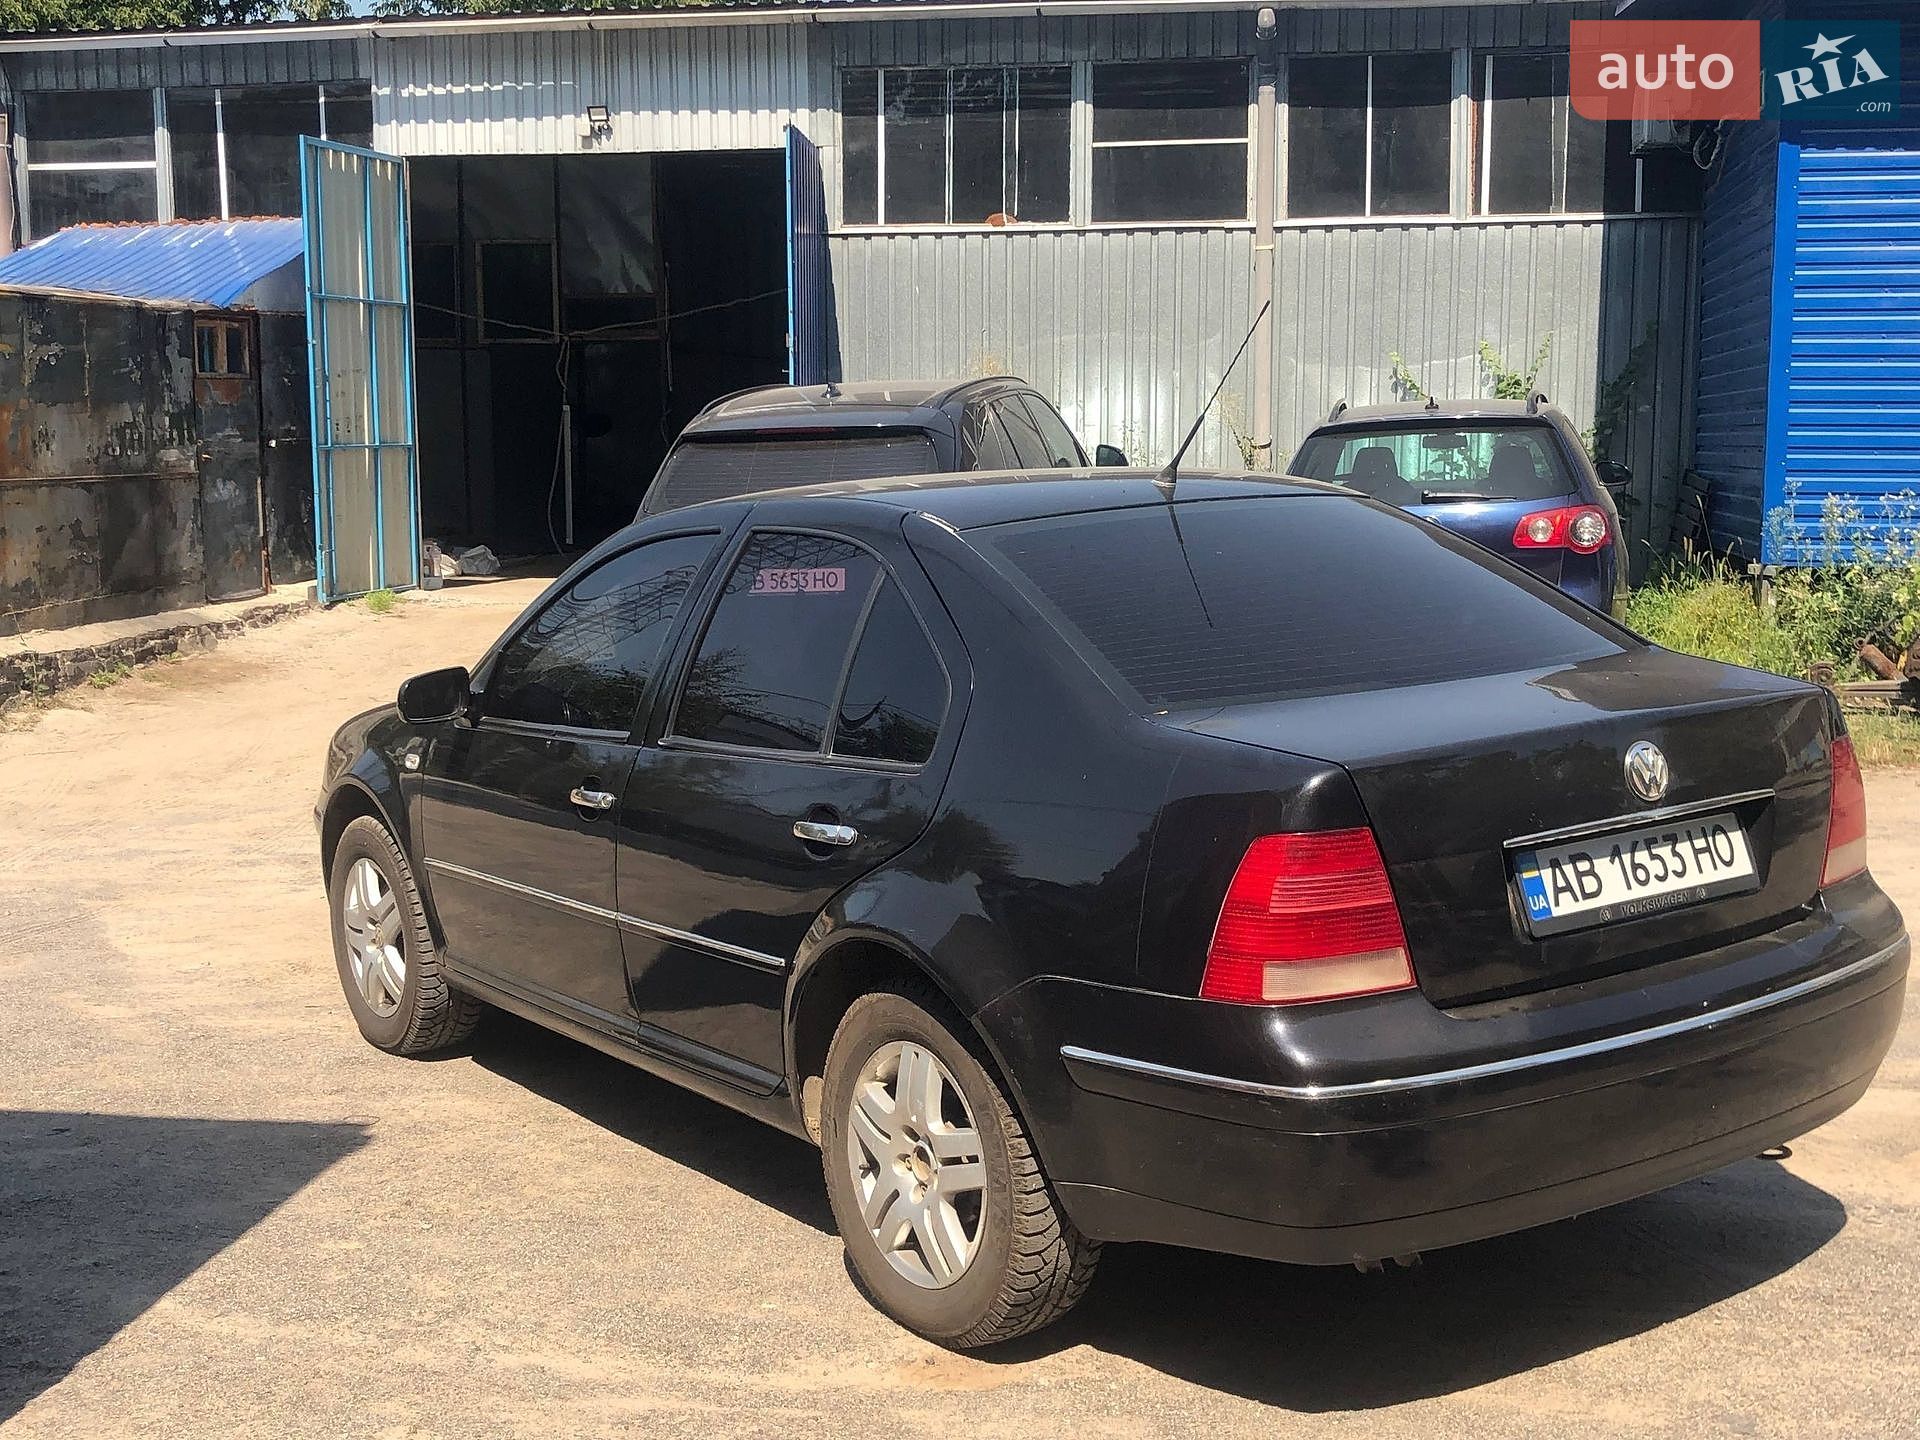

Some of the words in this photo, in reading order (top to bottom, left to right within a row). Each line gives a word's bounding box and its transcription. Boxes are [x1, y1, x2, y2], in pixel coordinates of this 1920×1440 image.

[813, 571, 839, 589] HO
[1550, 852, 1603, 907] AB
[1609, 832, 1688, 890] 1653
[1686, 823, 1735, 874] HO
[1529, 894, 1549, 911] UA
[1621, 890, 1690, 916] VOLKSWAGEN
